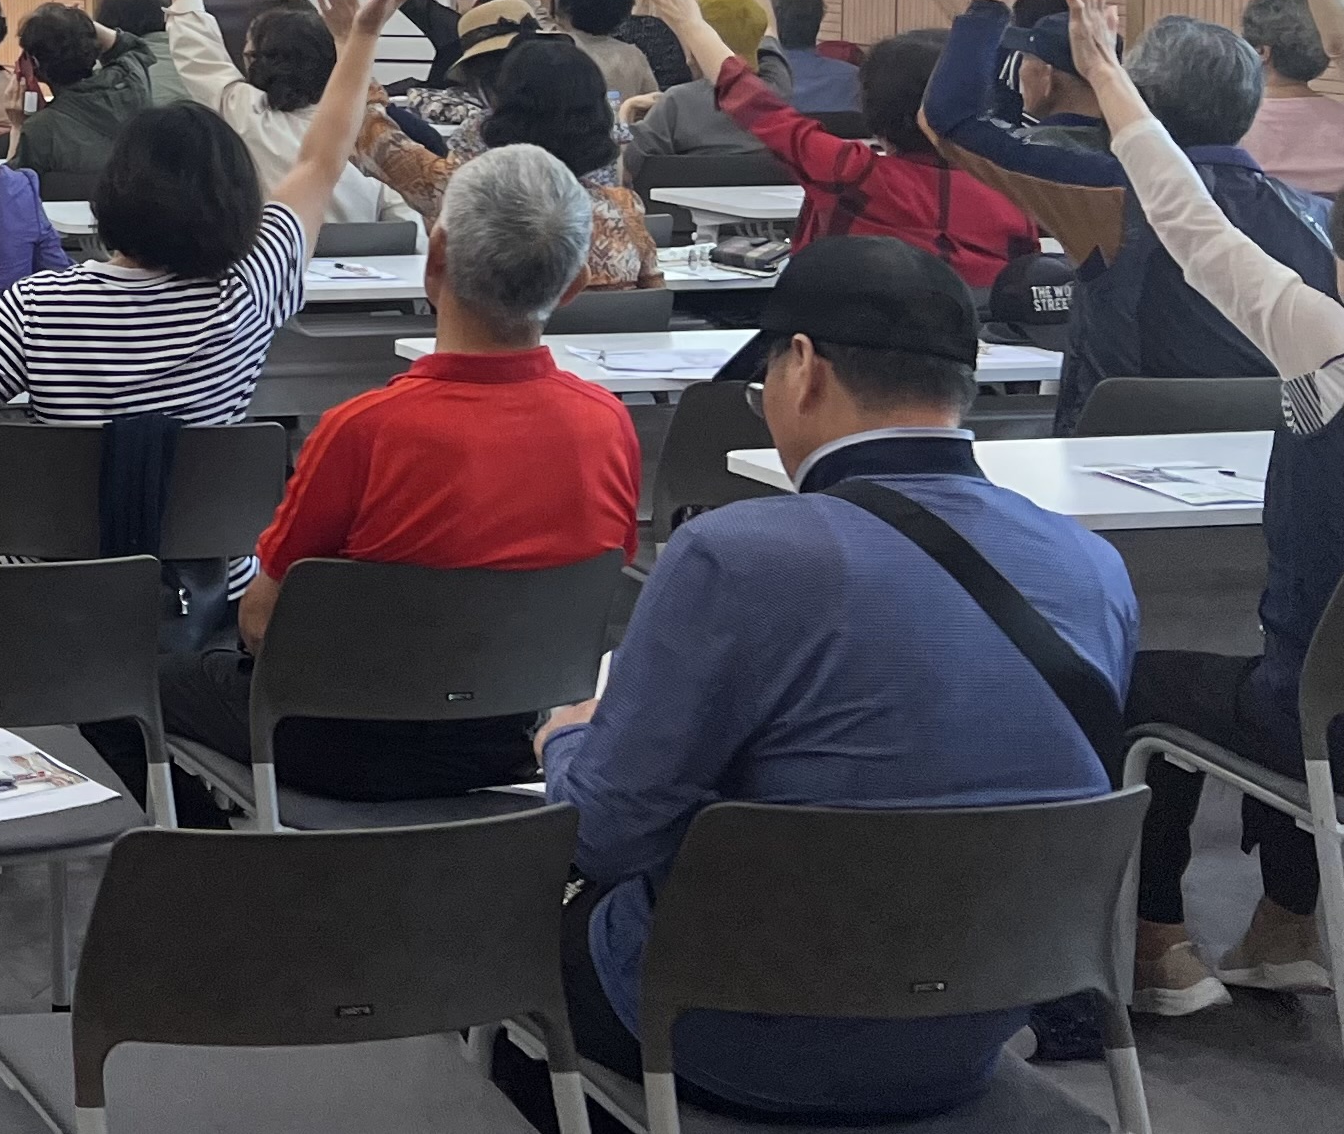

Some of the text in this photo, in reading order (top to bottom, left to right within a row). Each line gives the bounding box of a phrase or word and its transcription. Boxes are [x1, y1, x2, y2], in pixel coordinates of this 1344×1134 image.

[1031, 284, 1072, 298] THE WO
[1033, 297, 1070, 311] STREE
